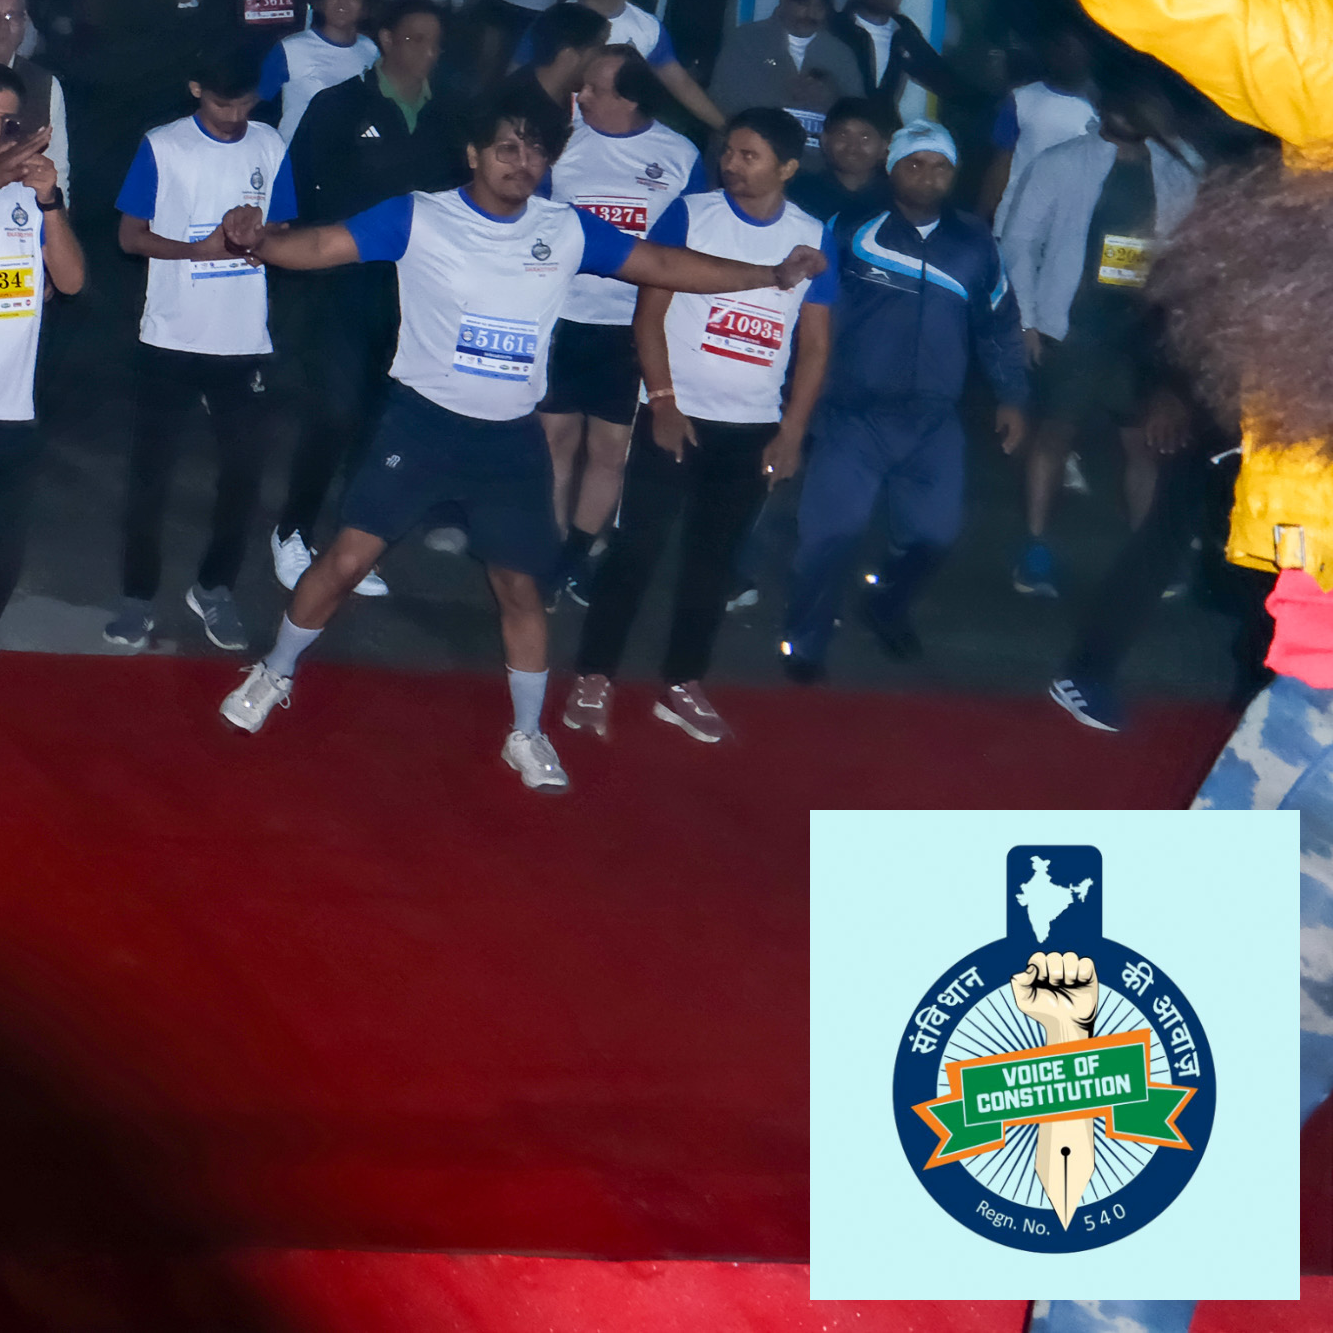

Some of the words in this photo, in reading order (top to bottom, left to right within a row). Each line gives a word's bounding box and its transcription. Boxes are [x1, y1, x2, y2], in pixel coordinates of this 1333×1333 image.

[589, 207, 636, 225] 1327
[724, 312, 773, 339] 1093
[475, 330, 524, 353] 5161
